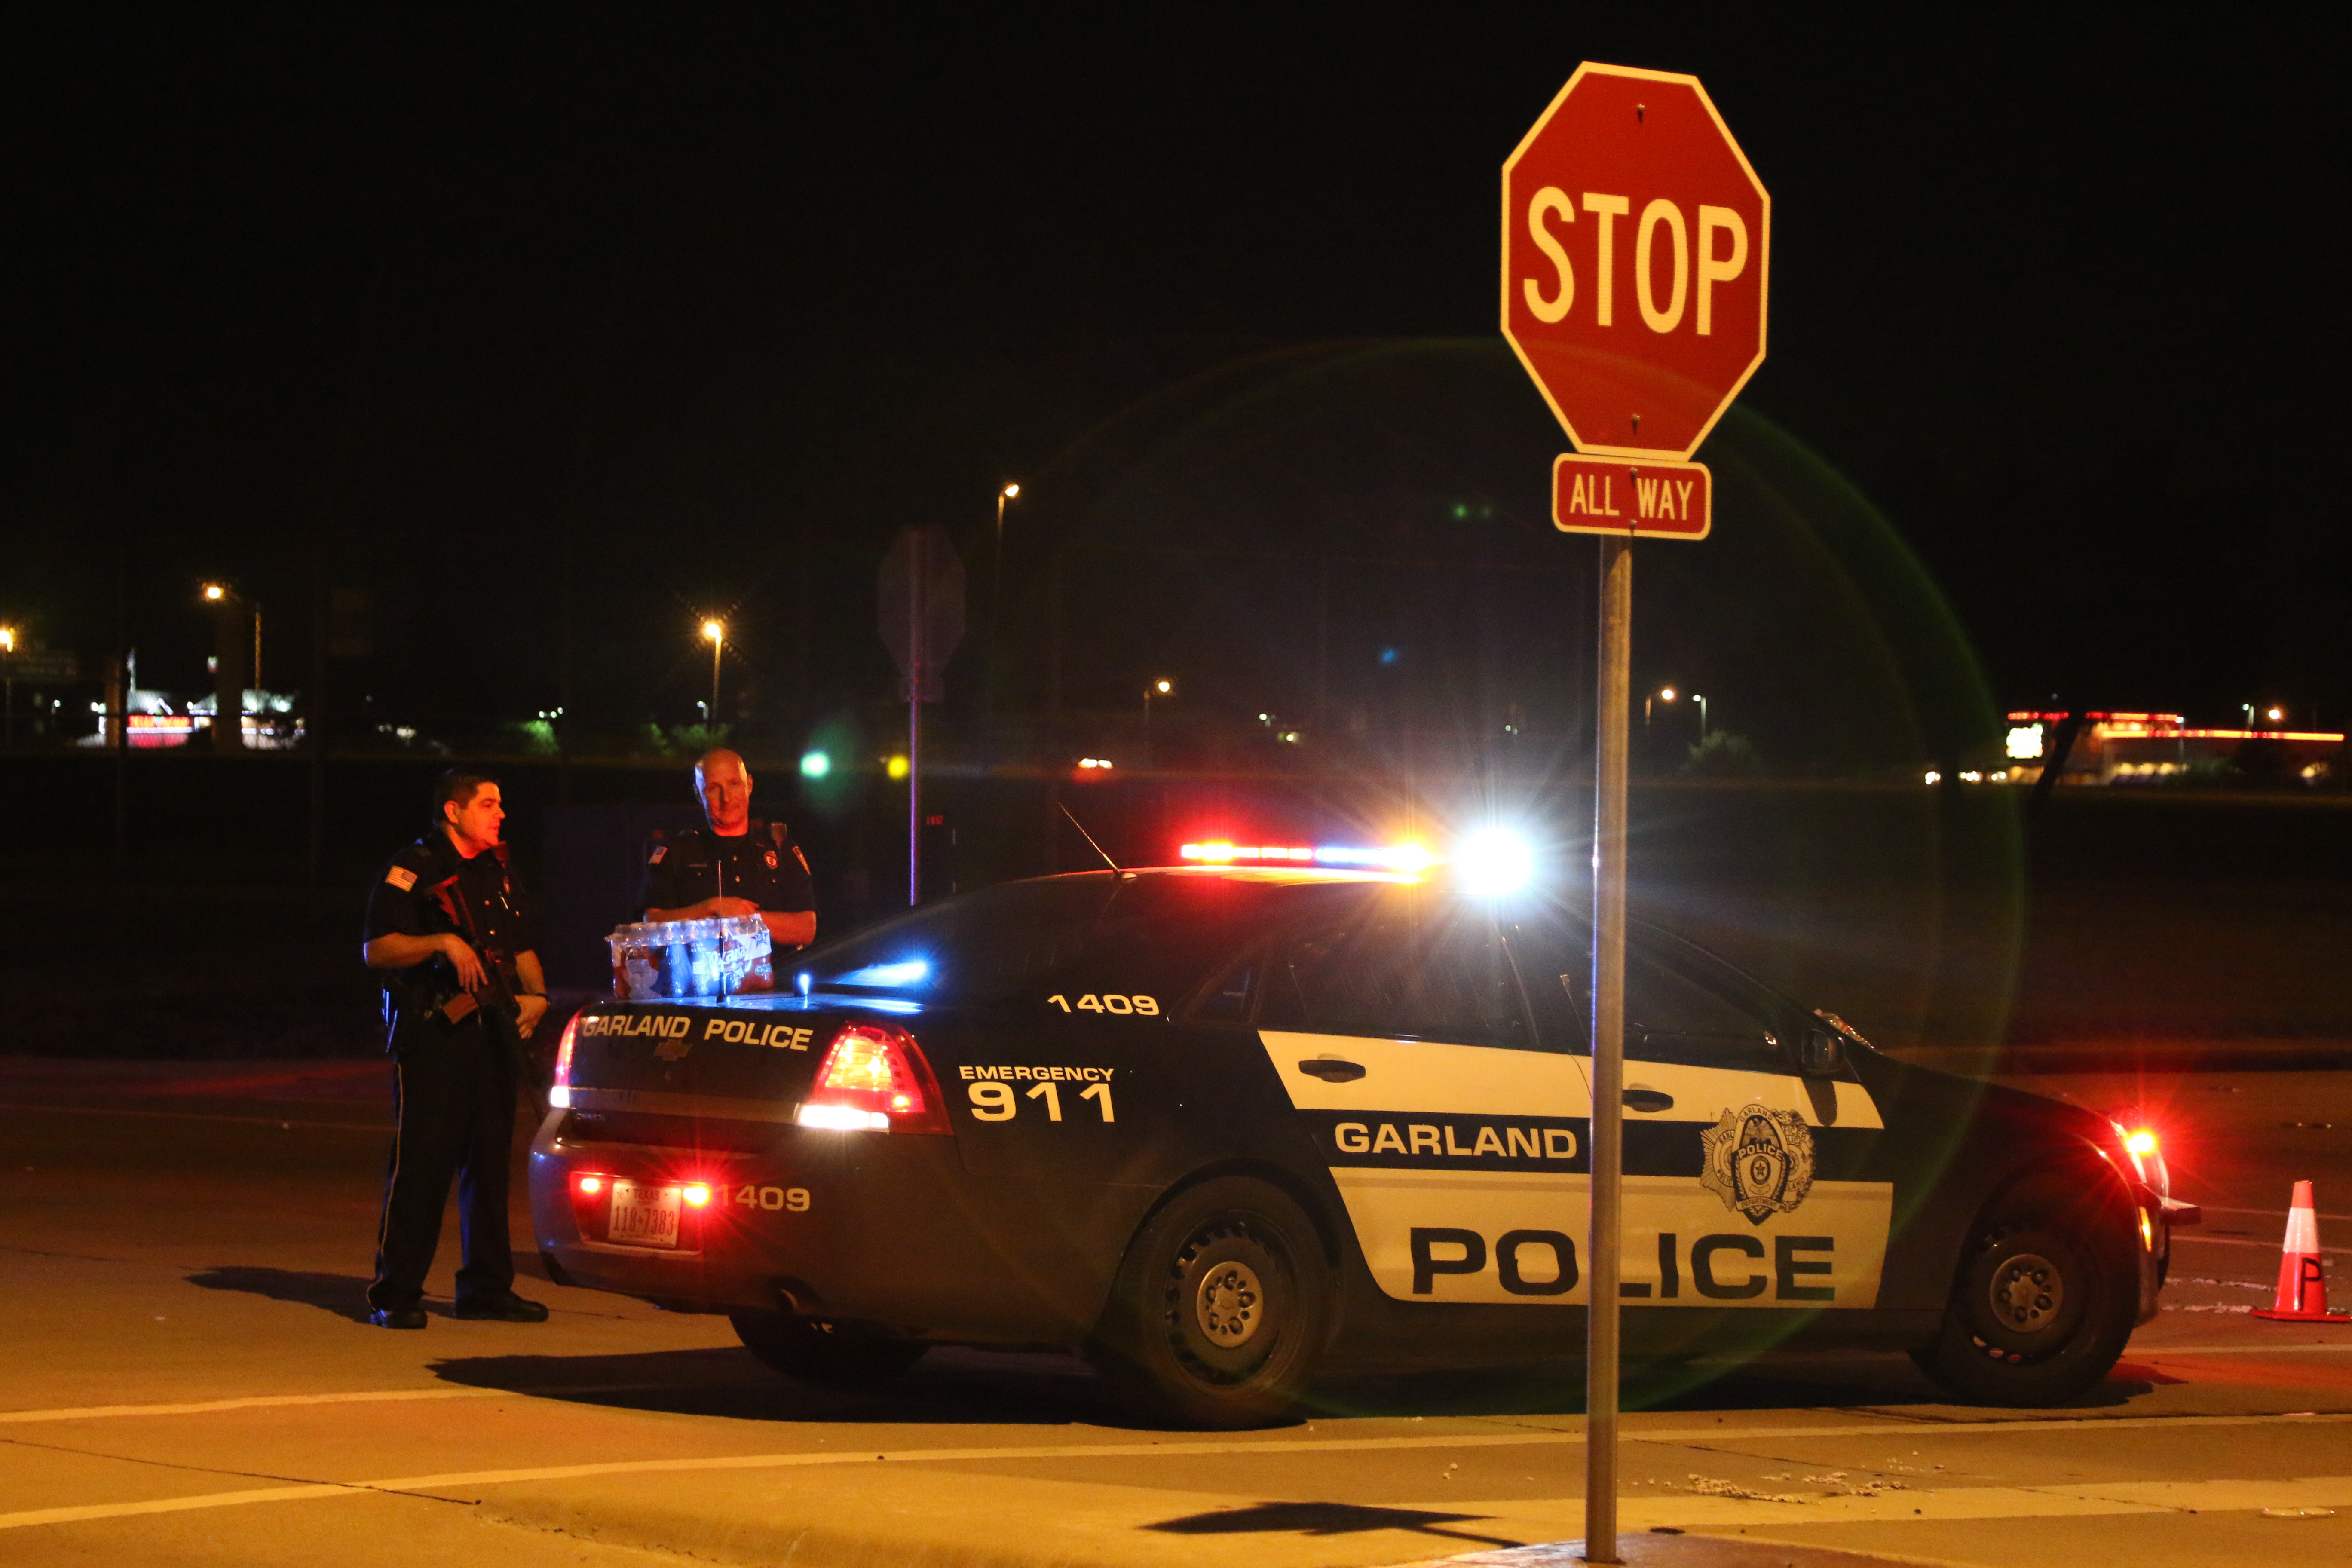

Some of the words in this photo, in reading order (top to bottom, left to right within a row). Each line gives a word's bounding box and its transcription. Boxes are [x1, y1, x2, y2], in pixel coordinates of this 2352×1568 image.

[1524, 186, 1748, 335] STOP
[1570, 474, 1620, 516] ALL
[1637, 477, 1694, 521] WAY
[1047, 994, 1160, 1016] 1409
[582, 1015, 690, 1038] GARLAND
[704, 1019, 813, 1051] POLICE
[959, 1066, 1114, 1081] EMERGENCY
[968, 1081, 1115, 1122] 911
[1740, 1106, 1773, 1122] GARLAND
[1335, 1122, 1577, 1158] GARLAND
[1738, 1143, 1783, 1161] POLICE
[715, 1184, 810, 1212] 1409
[1410, 1227, 1835, 1301] POICE
[2300, 1257, 2322, 1311] P
